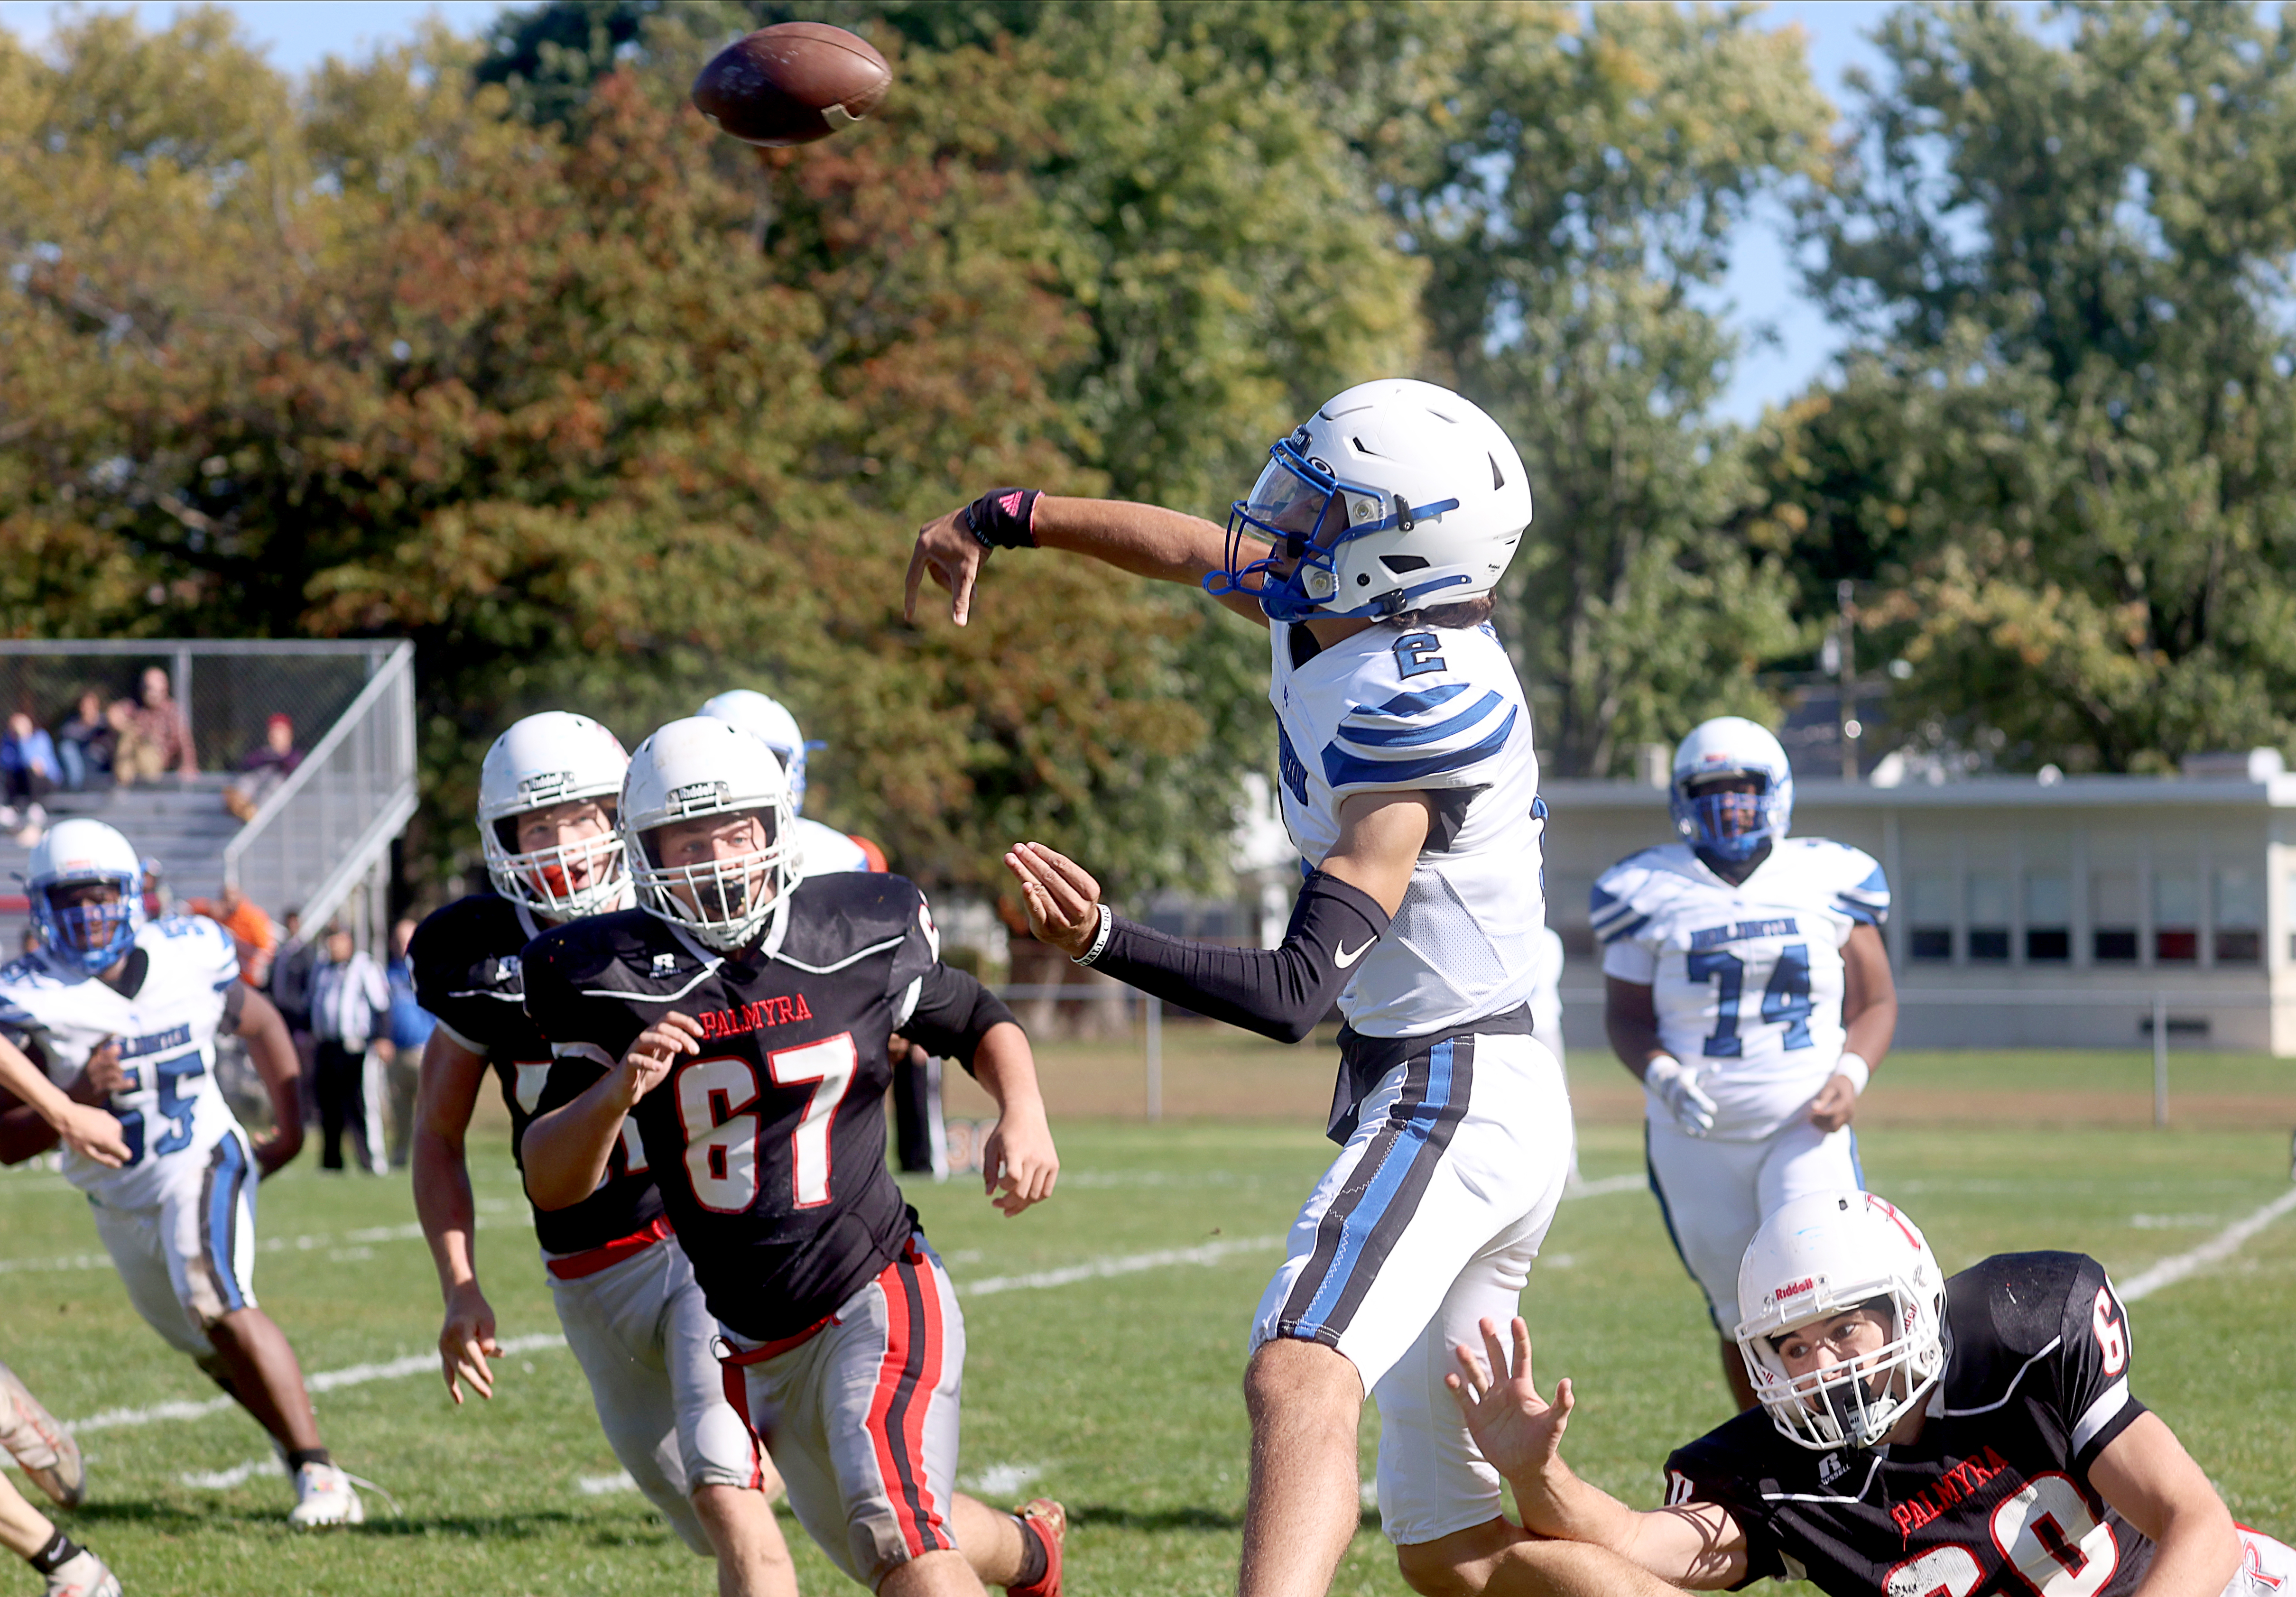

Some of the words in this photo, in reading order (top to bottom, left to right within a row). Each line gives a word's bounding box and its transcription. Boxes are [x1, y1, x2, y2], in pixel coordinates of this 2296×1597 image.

[1392, 632, 1447, 680] 2
[1102, 905, 1110, 932] CHO
[699, 993, 813, 1040] PALMYRA
[1687, 944, 1818, 1057] 74
[674, 1031, 858, 1215] 67
[1776, 1278, 1813, 1301] Riddell
[2092, 1273, 2132, 1377] 6
[1889, 1445, 2009, 1538] PALMYRA
